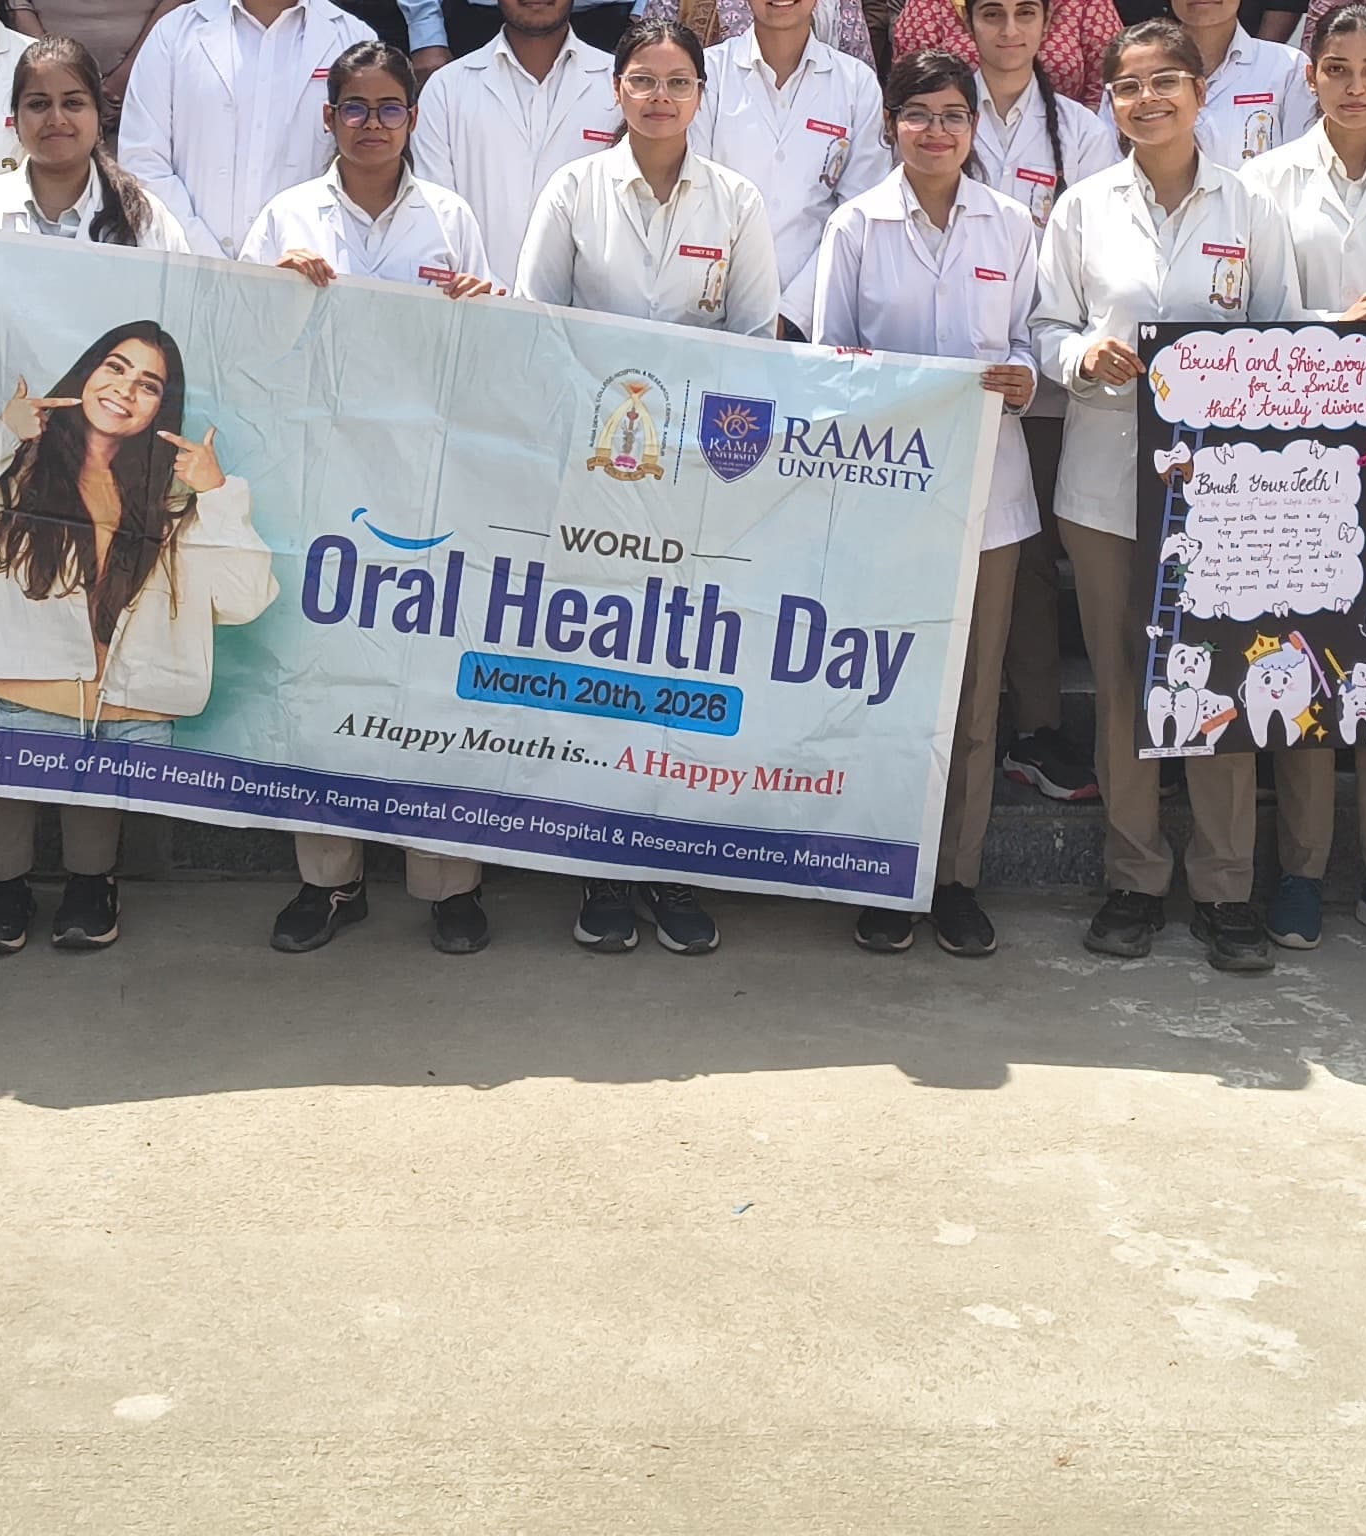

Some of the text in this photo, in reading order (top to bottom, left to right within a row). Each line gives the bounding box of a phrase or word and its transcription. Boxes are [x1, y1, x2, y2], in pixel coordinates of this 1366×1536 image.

[1246, 348, 1281, 372] and
[1287, 346, 1330, 378] Shine,
[1248, 373, 1349, 399] for a Smile
[1205, 397, 1247, 422] that's
[1257, 395, 1312, 425] truly
[709, 437, 758, 454] RAMA
[779, 415, 935, 470] RAMA
[778, 457, 933, 493] UNIVERSITY
[1195, 471, 1239, 496] Brush
[1248, 472, 1288, 493] Your
[560, 524, 684, 565] WORLD
[300, 534, 916, 706] Oral Health Day
[471, 664, 729, 724] March 20th, 2026
[333, 713, 847, 797] A Happy Mouth is... A Happy Mind!
[18, 747, 69, 773] Dept.
[73, 754, 96, 774] of
[98, 756, 158, 782] Public
[162, 764, 227, 792] Health
[230, 775, 322, 808] Dentistry,
[325, 789, 380, 814] Rama
[385, 797, 448, 822] Dental
[451, 803, 526, 834] College
[528, 814, 609, 846] Hospital
[611, 828, 626, 847] &
[631, 830, 718, 858] Research
[722, 841, 788, 867] Centre,
[793, 848, 892, 876] Mandhana
